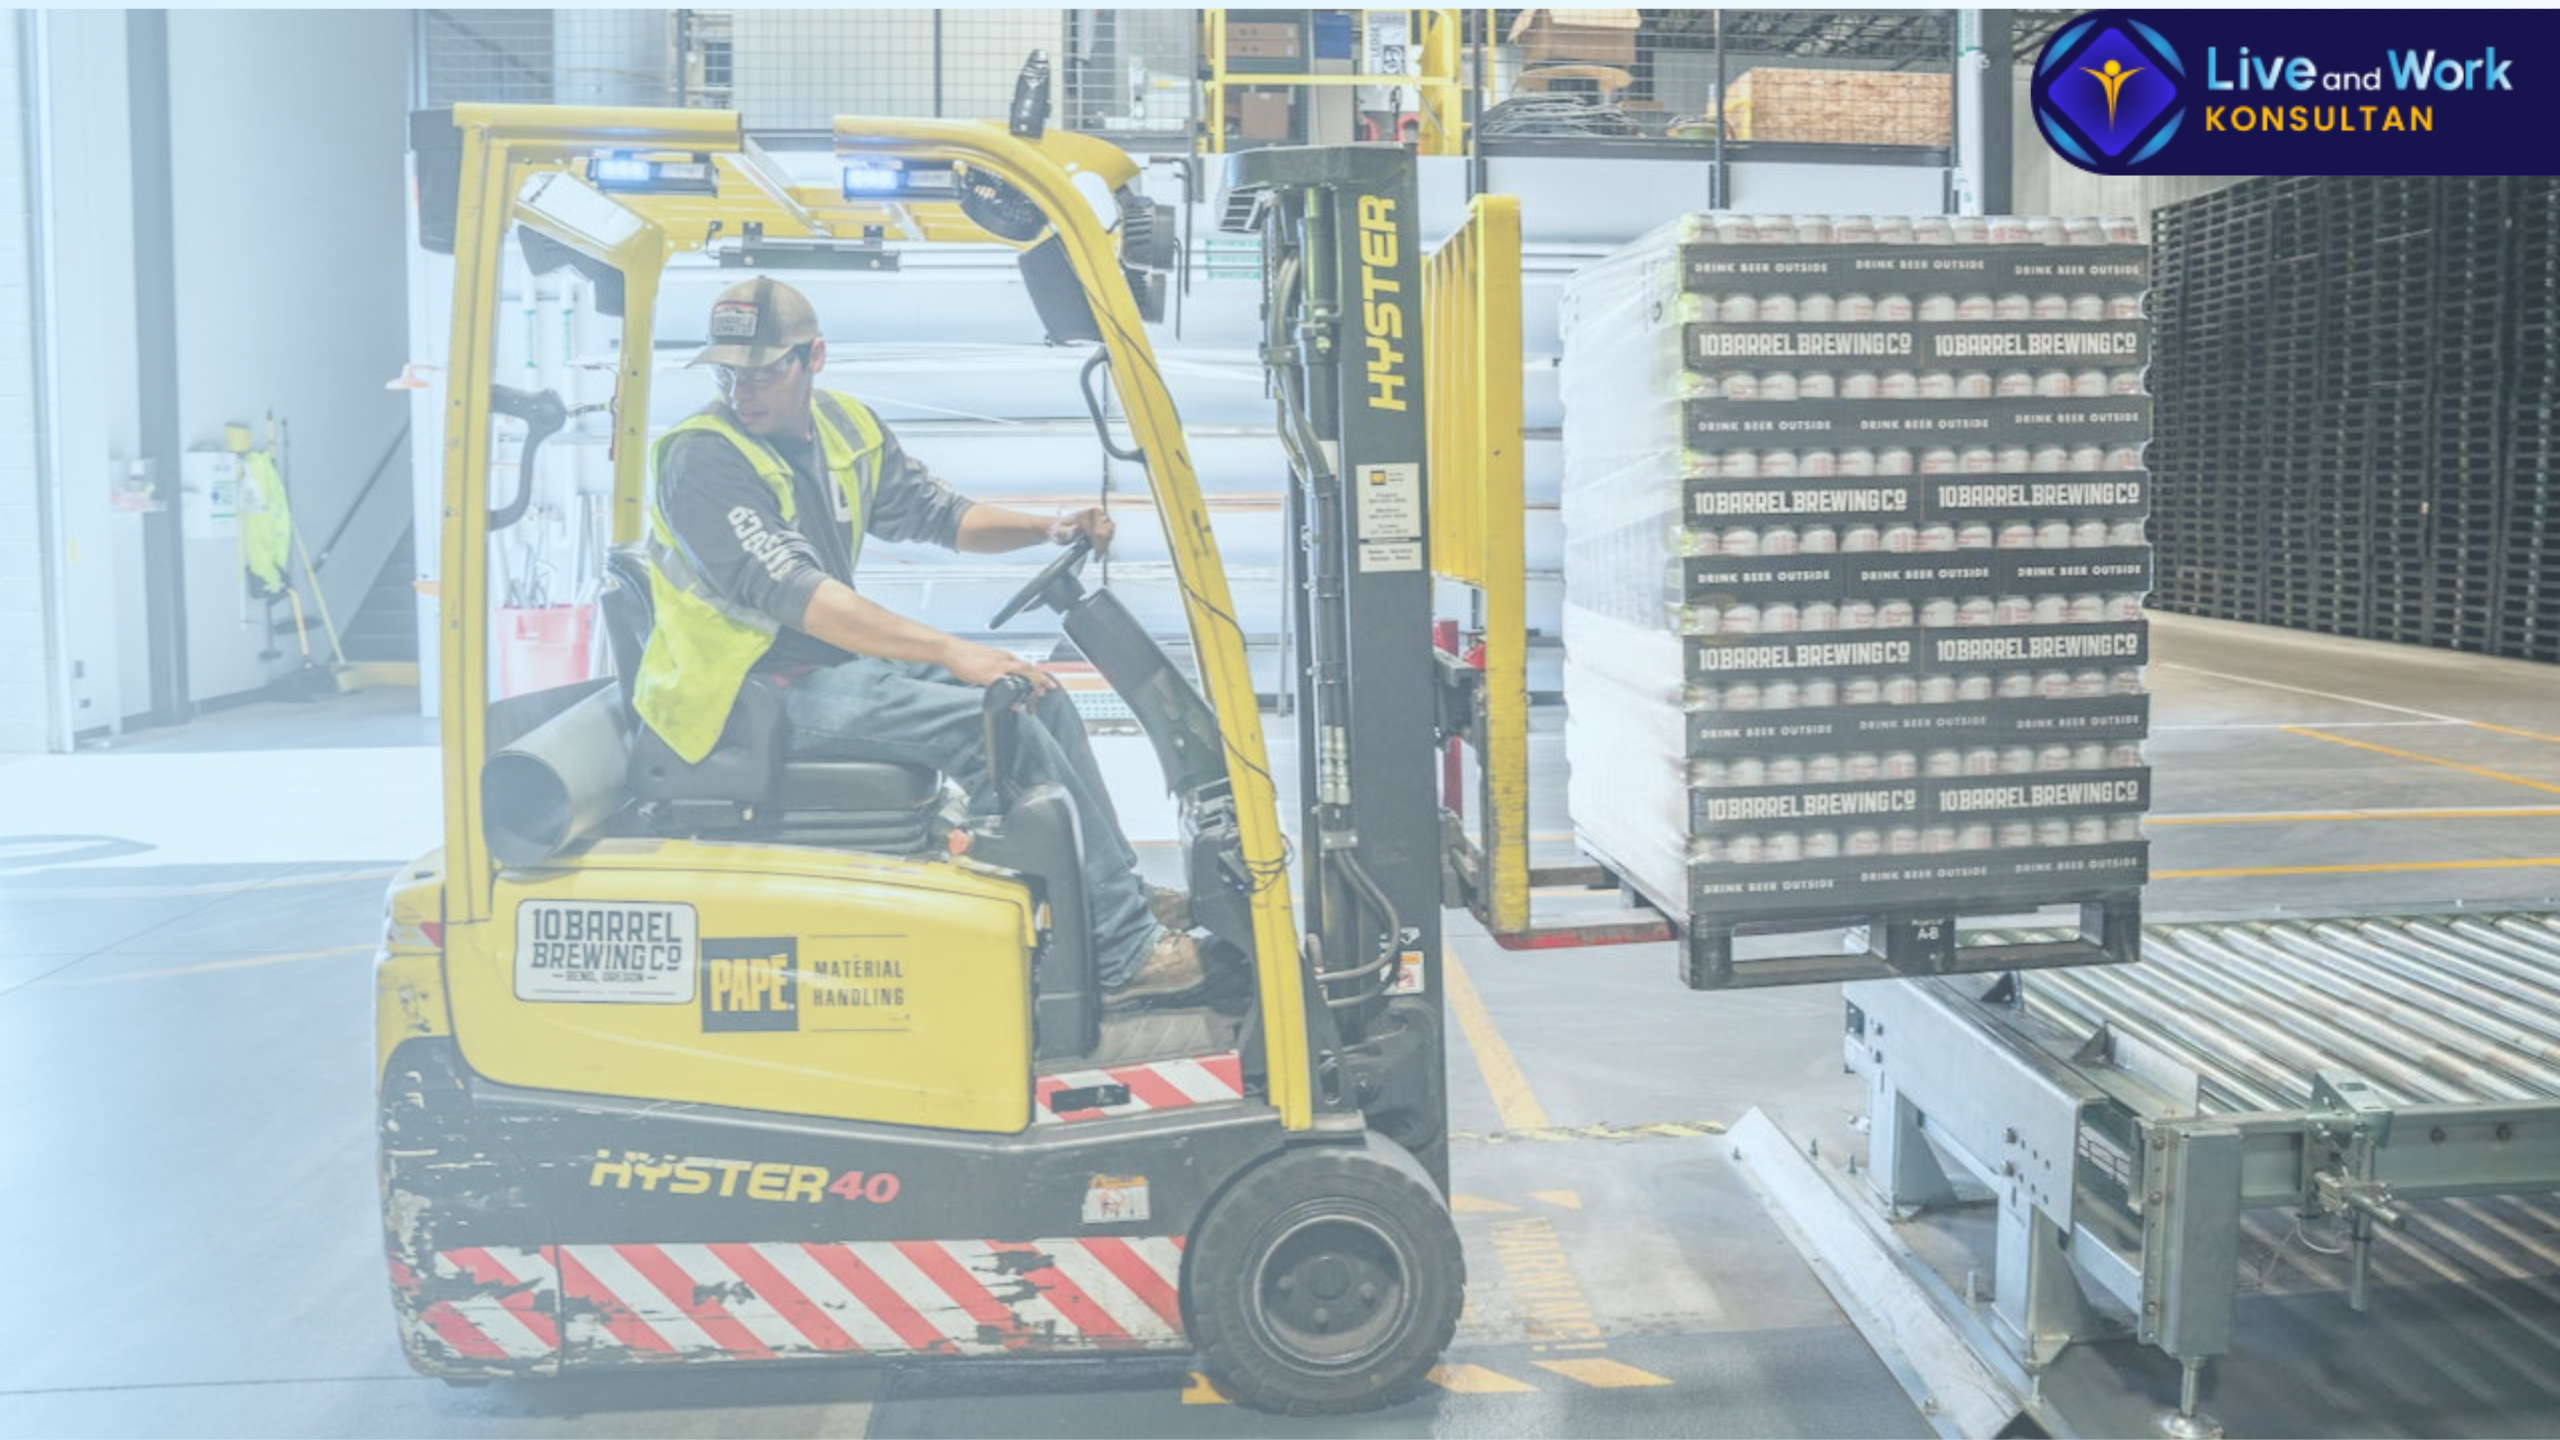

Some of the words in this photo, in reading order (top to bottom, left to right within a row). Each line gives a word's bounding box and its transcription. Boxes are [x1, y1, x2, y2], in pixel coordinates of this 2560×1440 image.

[1358, 195, 1407, 412] HYSTER
[814, 959, 905, 979] MATERIAL
[813, 987, 905, 1007] HANDLING
[588, 1149, 831, 1204] HYSTER
[828, 1170, 901, 1205] 40
